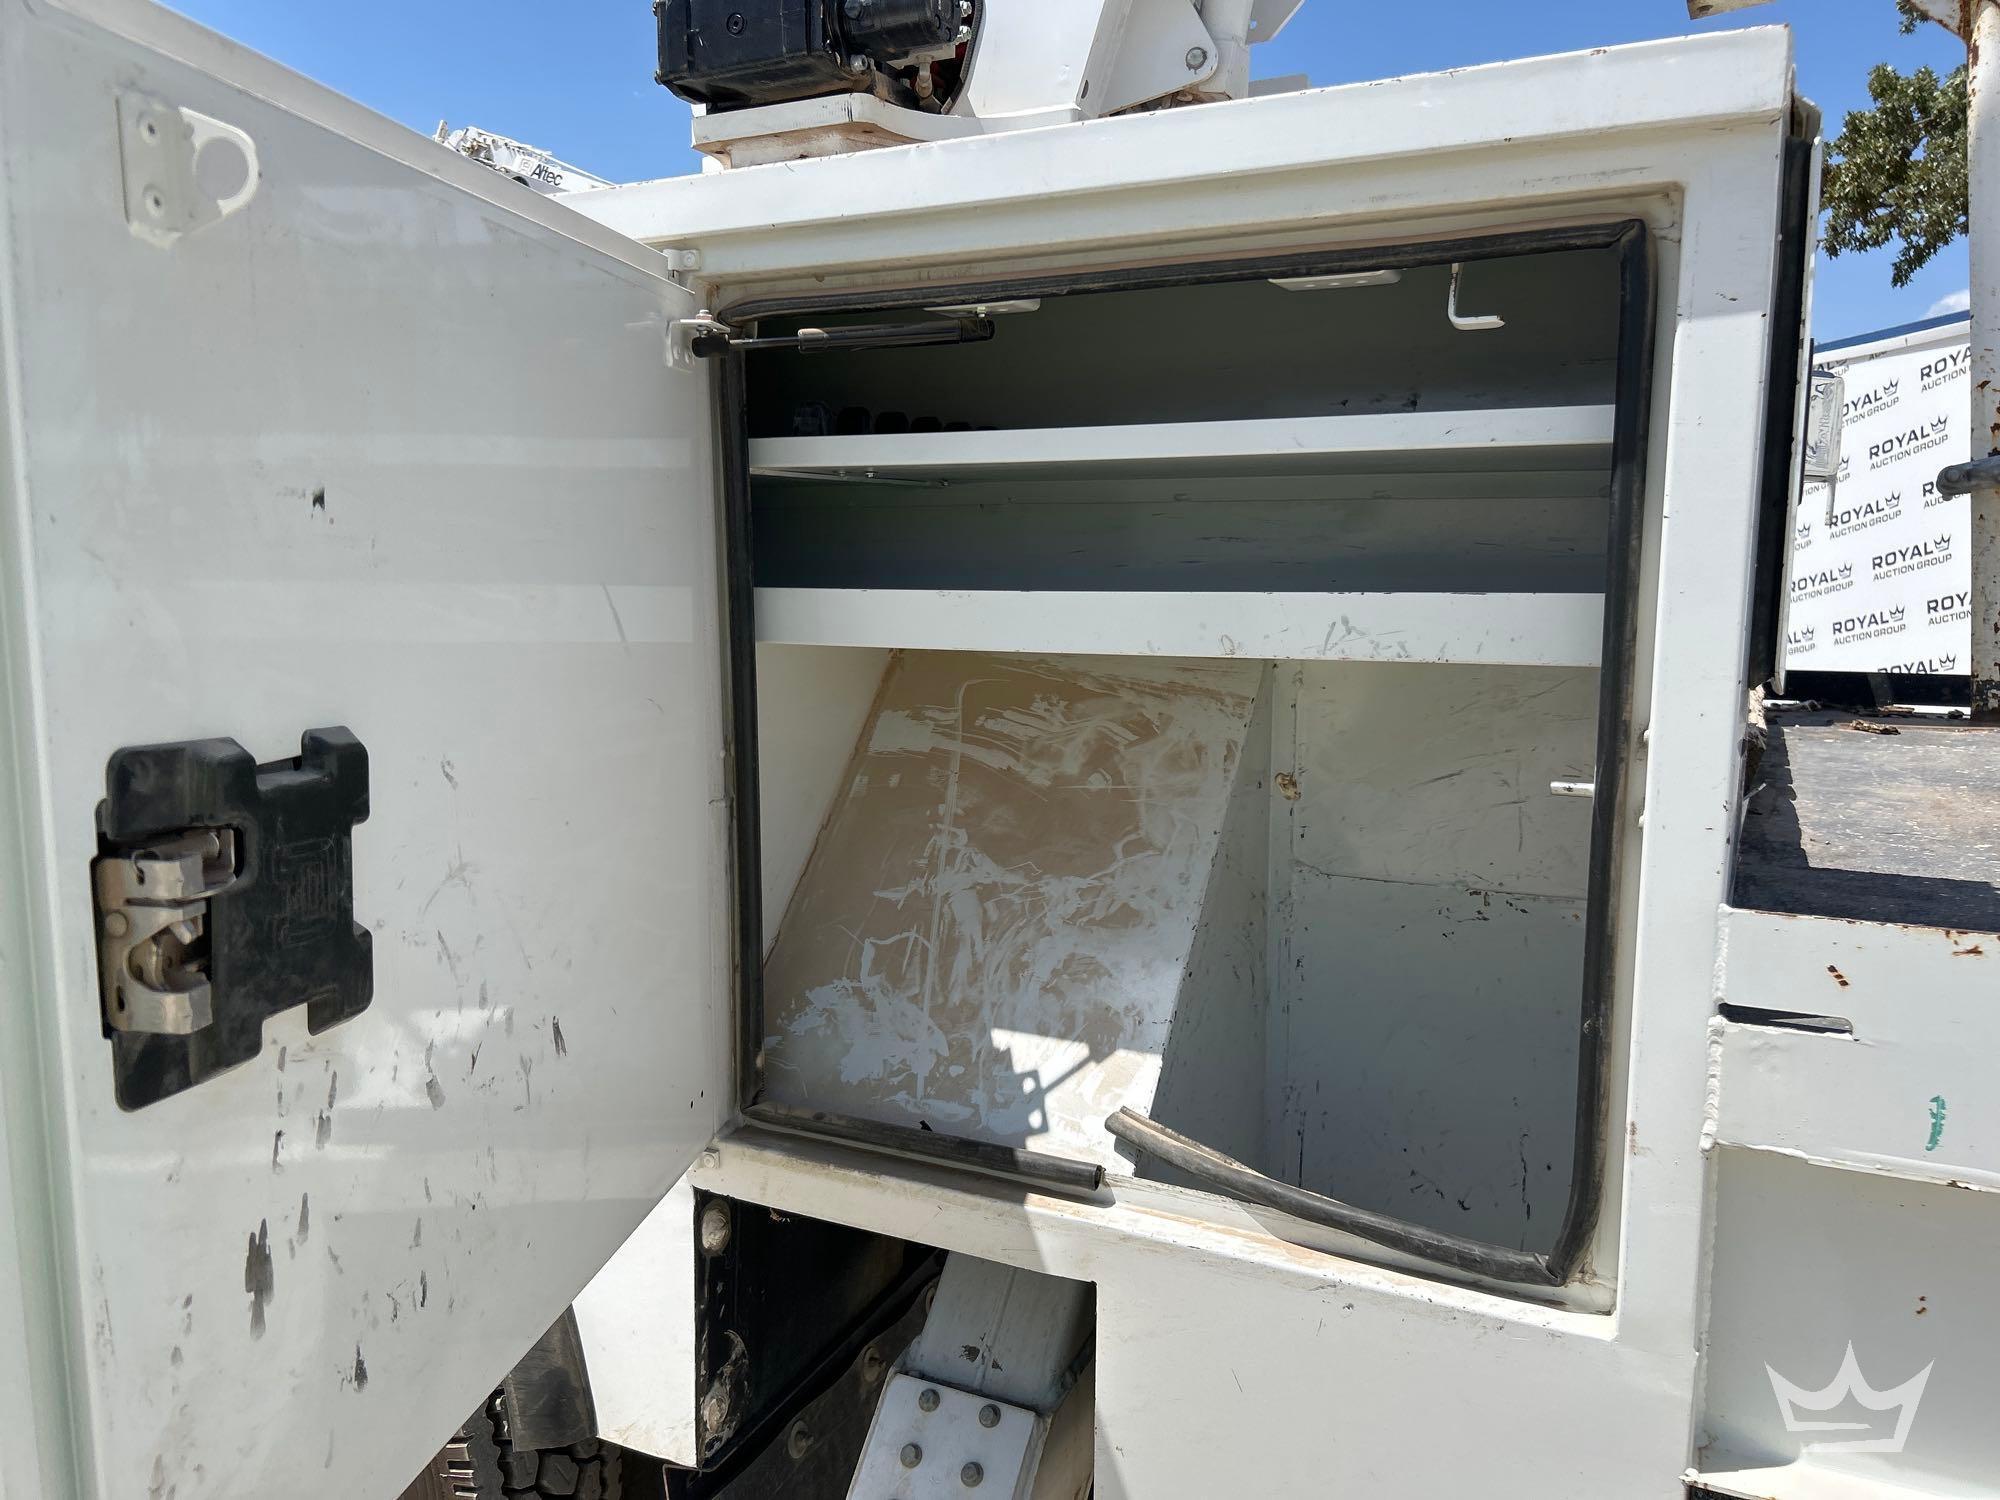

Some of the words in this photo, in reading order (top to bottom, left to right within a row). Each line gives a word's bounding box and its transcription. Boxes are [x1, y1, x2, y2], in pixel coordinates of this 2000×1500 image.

[531, 163, 564, 187] Altec
[1920, 345, 1971, 381] ROYA
[1921, 367, 1967, 393] AUCTION
[1842, 389, 1883, 417] OYAL
[1867, 397, 1899, 416] GROUP
[1869, 426, 1930, 460] ROYAL
[1870, 448, 1911, 471] AUCTION
[1913, 434, 1948, 455] GROUP
[1829, 499, 1884, 529] ROYAL
[1830, 523, 1867, 540] AUCTION
[1869, 510, 1902, 526] GROUP
[1795, 540, 1812, 551] OUP
[1872, 542, 1934, 570] ROYAL
[1873, 564, 1915, 582] AUCTION
[1917, 553, 1952, 569] GROUP
[1790, 590, 1822, 603] UCTION
[1824, 581, 1853, 595] GROUP
[1927, 592, 1971, 615] ROY
[1832, 612, 1889, 635] ROYAL
[1834, 632, 1872, 646] AUCTION
[1874, 624, 1906, 638] GROUP
[1788, 643, 1815, 656] GROUP
